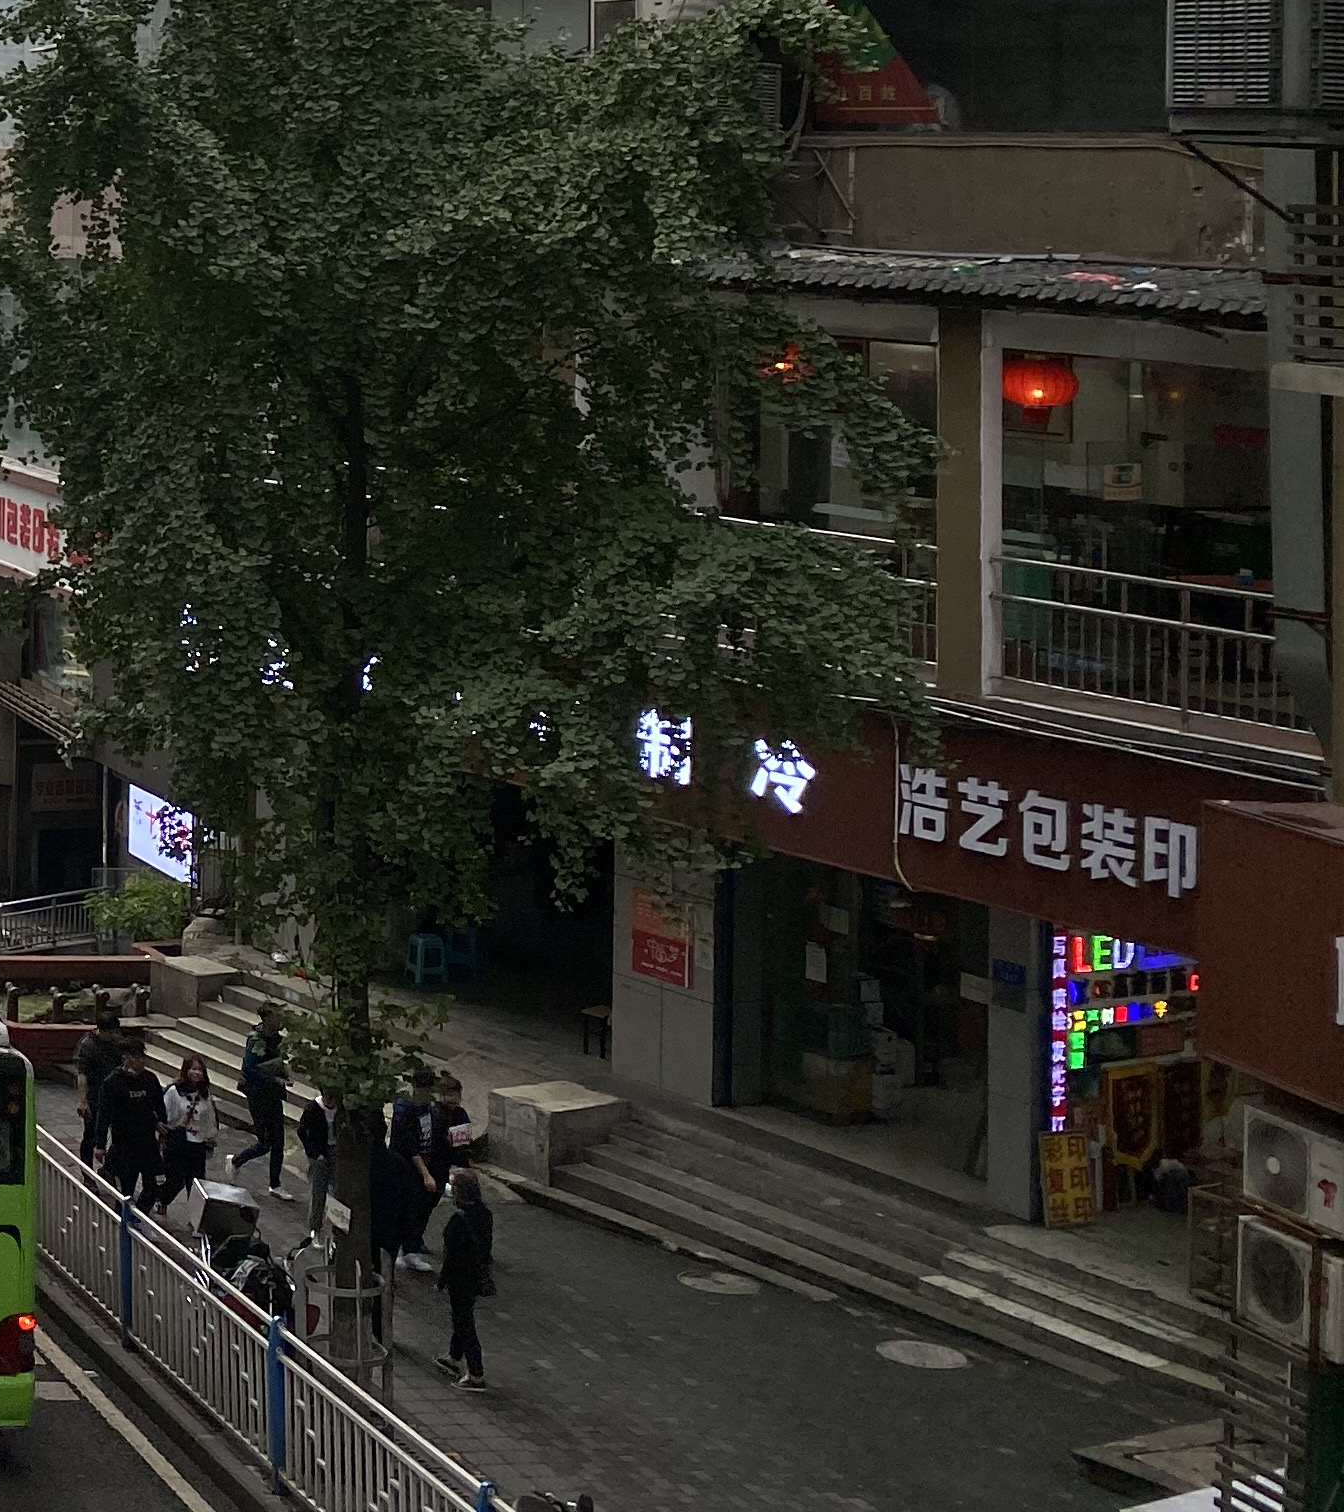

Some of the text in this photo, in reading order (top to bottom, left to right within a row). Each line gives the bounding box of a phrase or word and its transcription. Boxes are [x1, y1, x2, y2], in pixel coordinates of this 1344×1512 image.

[898, 763, 1198, 898] 浩艺包装印
[1072, 934, 1135, 973] LED
